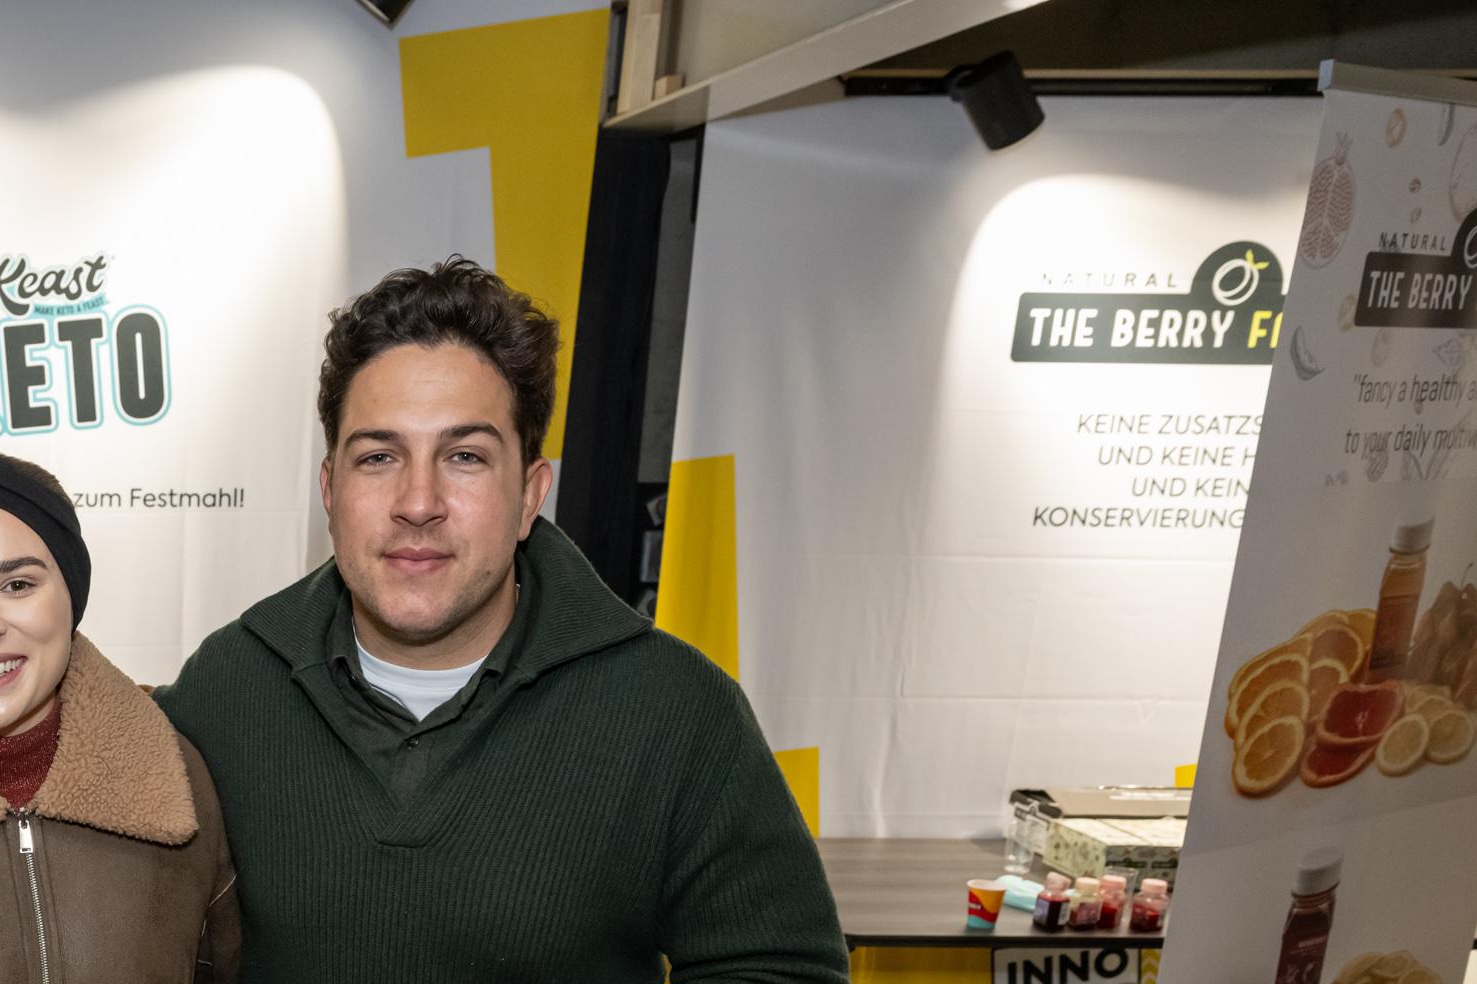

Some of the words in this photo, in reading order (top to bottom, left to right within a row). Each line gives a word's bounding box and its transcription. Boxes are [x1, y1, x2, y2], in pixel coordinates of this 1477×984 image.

[1379, 232, 1446, 251] NATURAL
[1042, 272, 1178, 288] NATURAL
[1368, 270, 1405, 308] THE
[1408, 272, 1473, 310] BERRY
[1029, 308, 1098, 347] THE
[1110, 309, 1235, 348] BERRY
[1077, 414, 1152, 434] KEINE
[1394, 424, 1431, 456] daily
[1098, 446, 1153, 465] UND
[1161, 447, 1235, 466] KEINE
[1132, 477, 1187, 497] UND
[73, 492, 121, 508] zum
[130, 488, 245, 508] Festmahl!
[1033, 507, 1245, 529] KONSERVIERUNG
